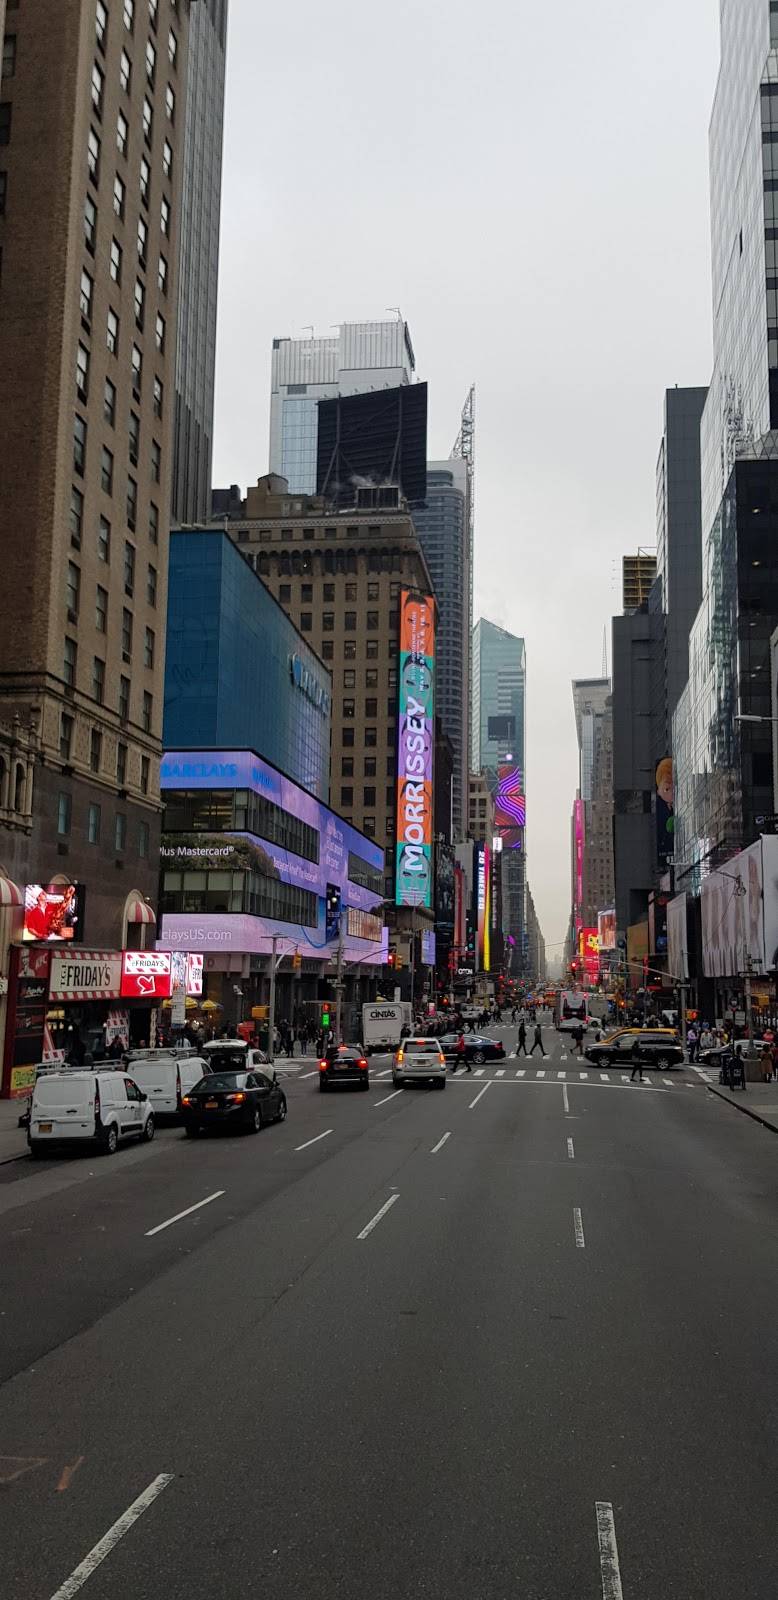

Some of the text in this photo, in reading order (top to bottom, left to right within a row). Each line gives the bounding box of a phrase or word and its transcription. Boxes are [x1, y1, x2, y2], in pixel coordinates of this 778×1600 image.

[160, 763, 238, 777] BARCLAYS
[405, 696, 426, 871] MORRISSEY
[66, 963, 111, 987] FRIDAY'S
